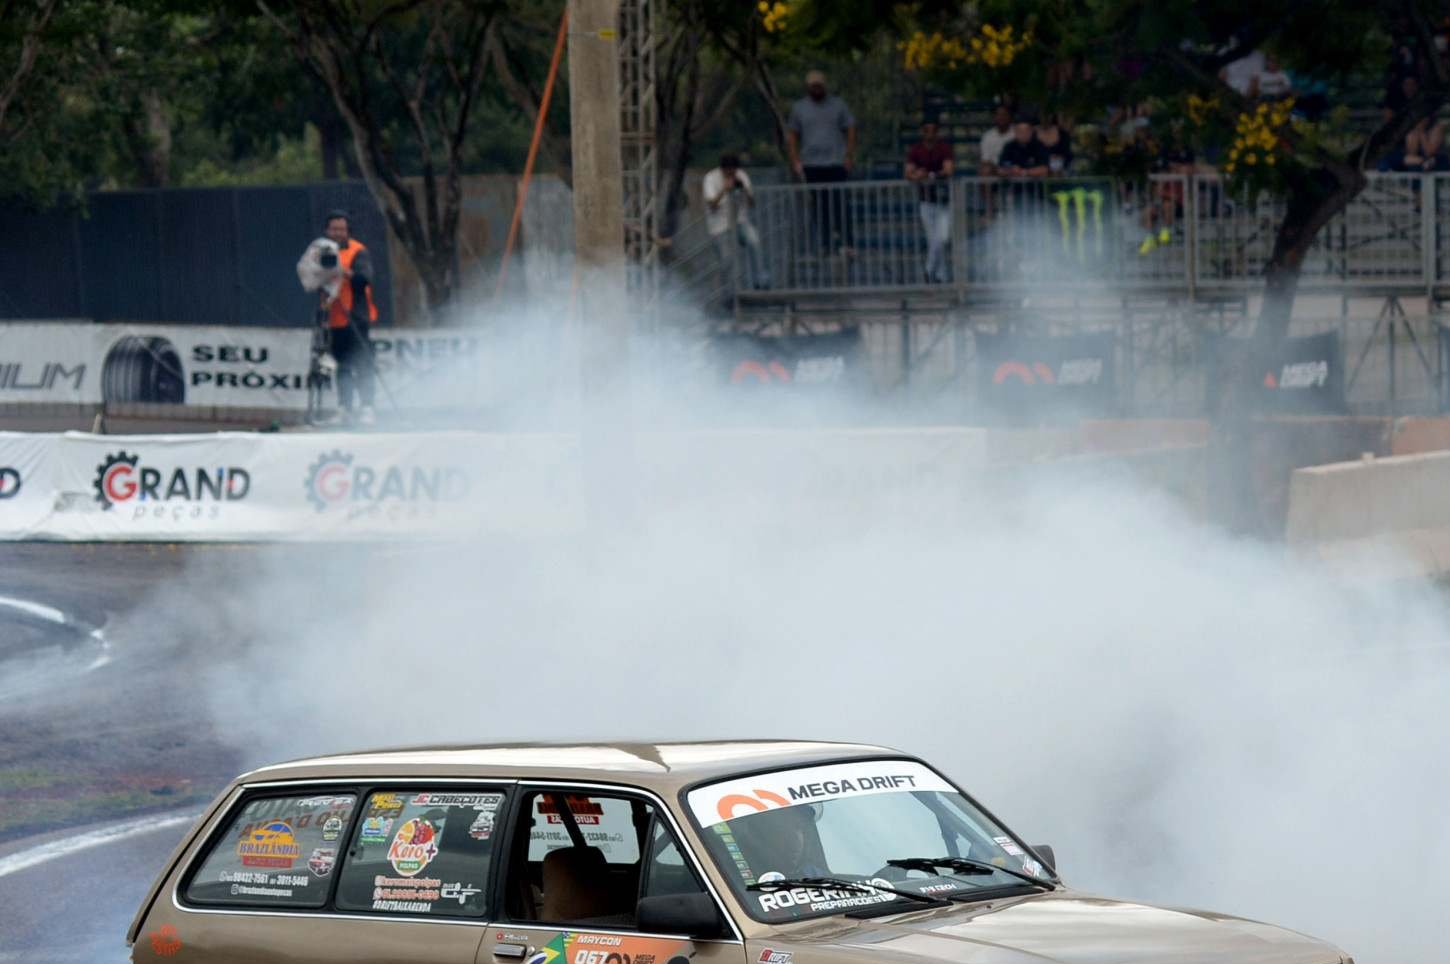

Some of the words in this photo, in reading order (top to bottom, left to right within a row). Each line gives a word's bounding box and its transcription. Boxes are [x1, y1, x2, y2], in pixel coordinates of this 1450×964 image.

[192, 345, 269, 364] SEU
[104, 464, 250, 503] GRAND
[787, 777, 855, 801] MEGA
[857, 774, 917, 792] DRIFT
[577, 934, 622, 947] MAYCON
